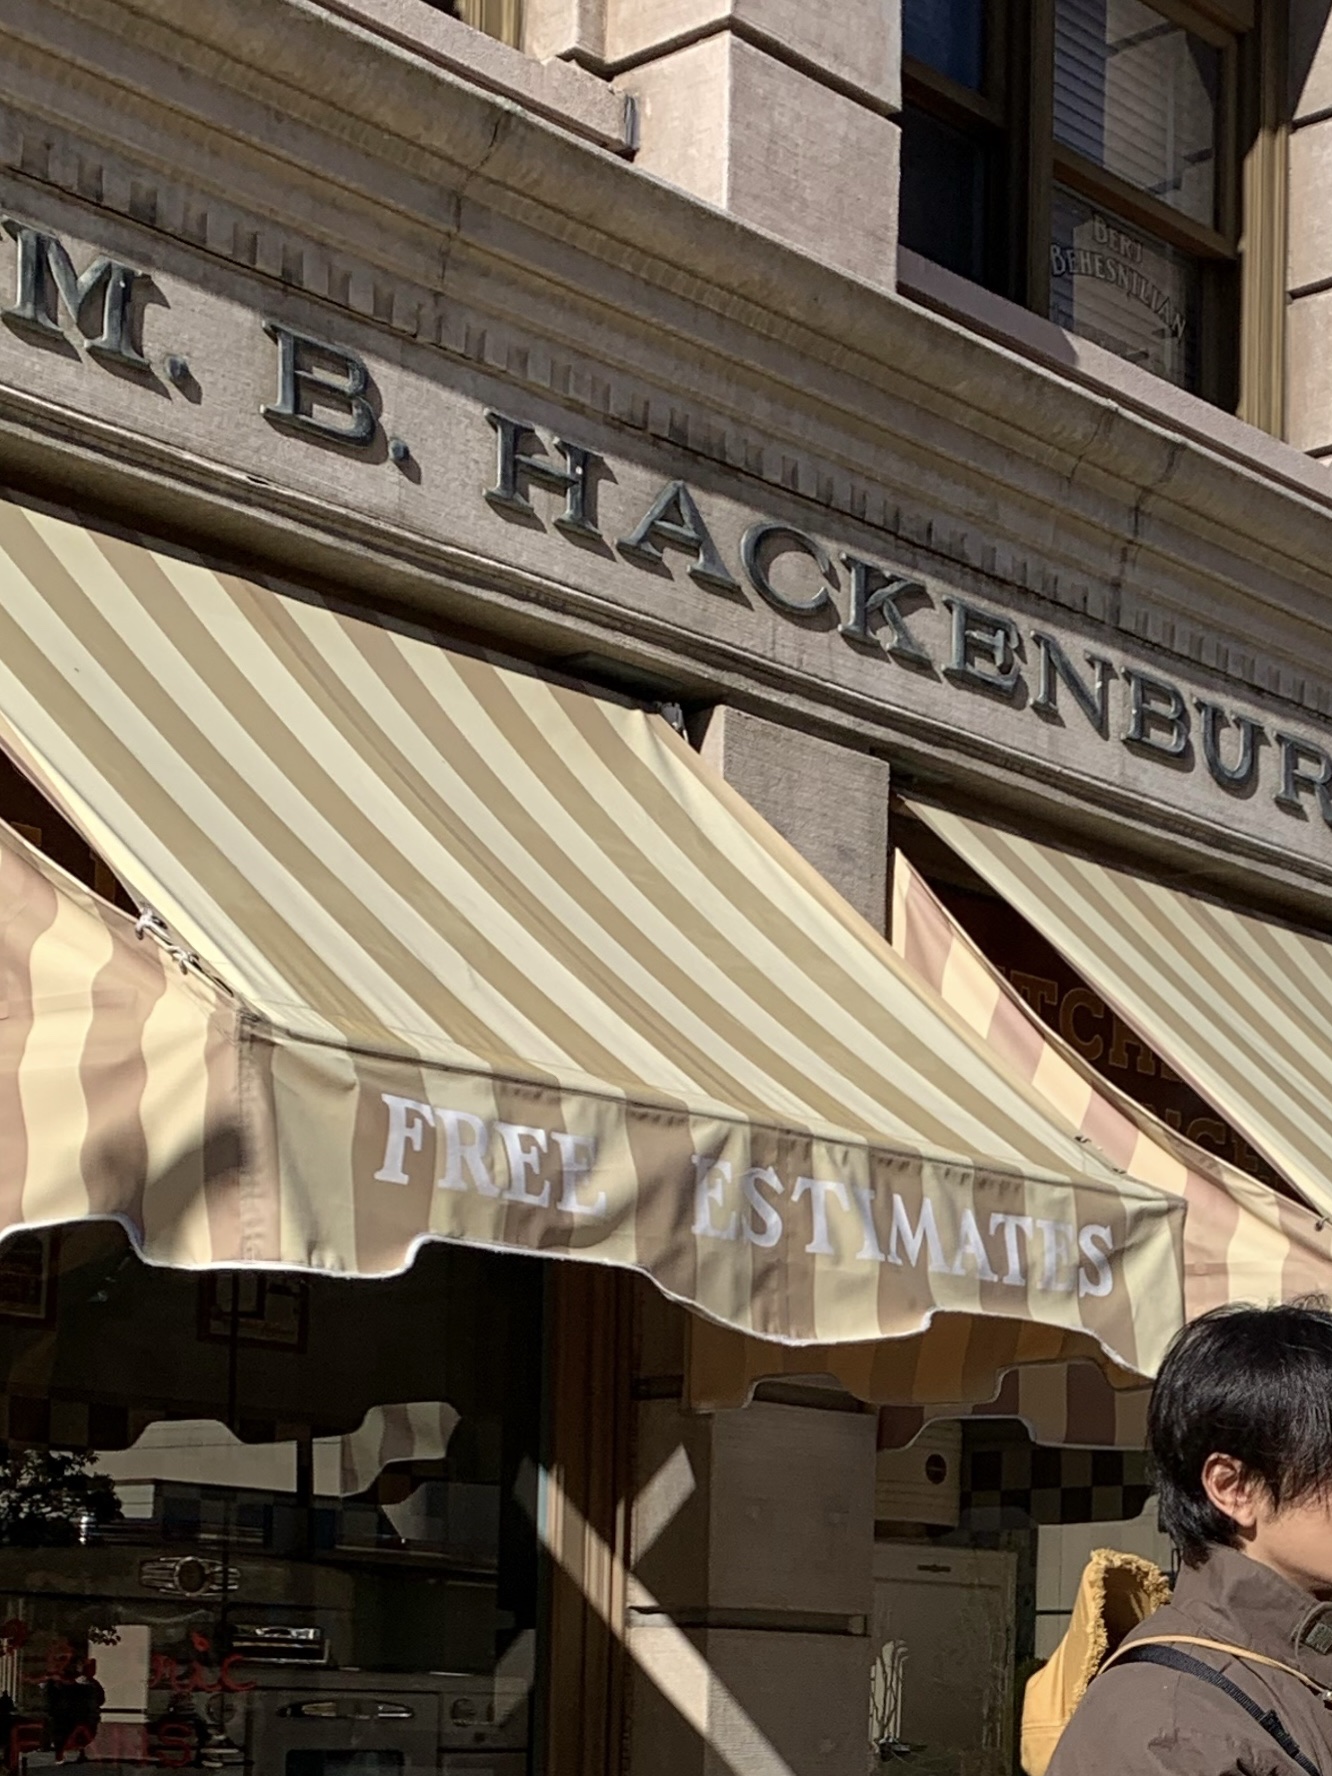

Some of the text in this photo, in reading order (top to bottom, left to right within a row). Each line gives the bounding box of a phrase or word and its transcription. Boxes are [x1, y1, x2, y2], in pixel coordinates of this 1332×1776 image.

[260, 321, 410, 463] B.
[374, 1092, 1116, 1298] FREE ESTIMATES
